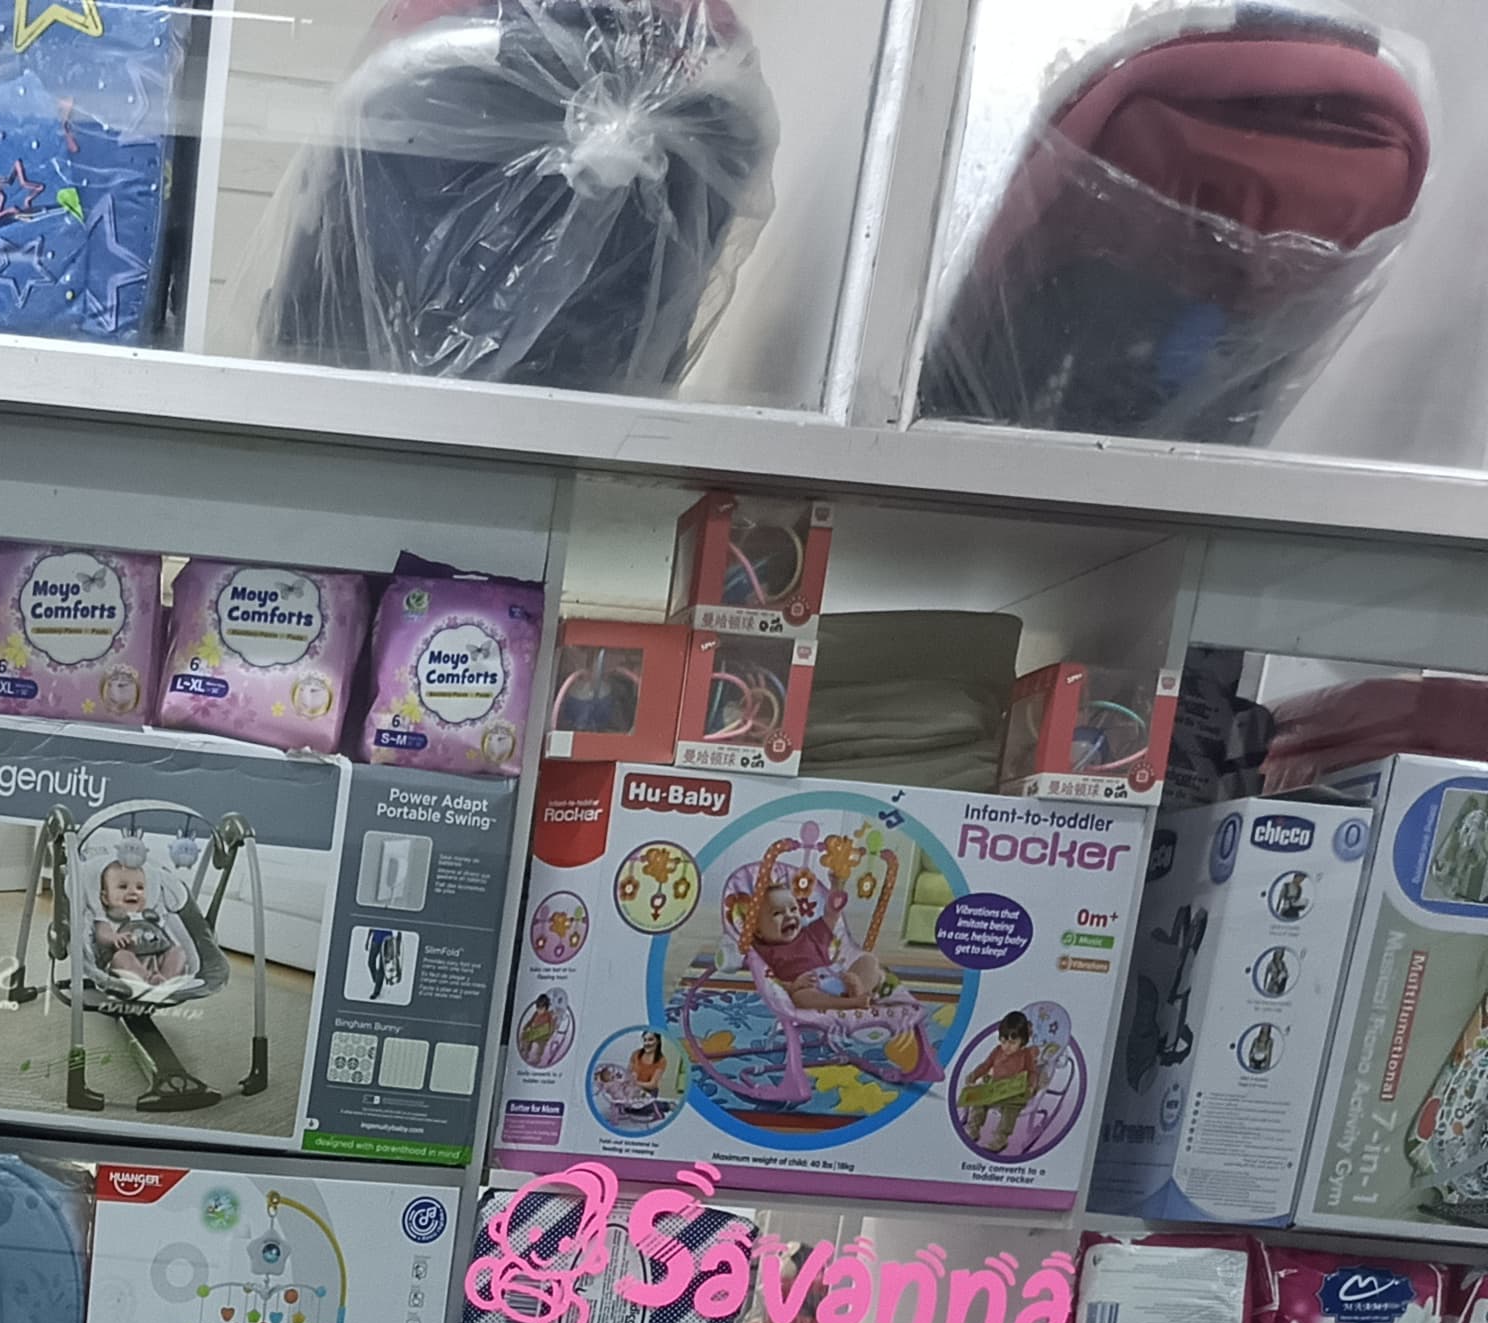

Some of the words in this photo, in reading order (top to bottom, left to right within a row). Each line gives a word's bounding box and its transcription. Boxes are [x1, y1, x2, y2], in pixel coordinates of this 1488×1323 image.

[32, 580, 81, 602] Moyo
[230, 586, 279, 607] Moyo
[31, 601, 117, 619] Comforts
[227, 605, 314, 628] Comforts
[428, 649, 470, 669] Moyo
[425, 668, 498, 687] Comforts
[388, 787, 438, 808] Power
[441, 794, 490, 813] Adapt
[376, 803, 442, 823] Portable
[543, 807, 604, 823] Rocker
[964, 803, 1114, 833] Infant-to-toddler
[1254, 820, 1312, 846] chicco
[957, 824, 1131, 872] Rocker
[955, 904, 999, 918] Vibrations
[1001, 910, 1020, 920] that
[957, 918, 988, 930] imitate
[989, 920, 1015, 933] being
[970, 931, 1003, 946] helping
[955, 944, 971, 956] get
[971, 944, 981, 954] to
[334, 1017, 373, 1031] Bingham
[1381, 954, 1426, 1100] Multifunctional
[1337, 1079, 1370, 1154] Activity
[314, 1136, 355, 1149] designed
[356, 1140, 375, 1150] with
[376, 1141, 427, 1156] parenthood
[428, 1147, 437, 1156] in
[712, 1152, 750, 1162] Maximum
[1352, 1110, 1398, 1204] 7-in-1
[961, 1161, 986, 1172] Easily
[988, 1165, 1026, 1175] converts
[1327, 1158, 1353, 1207] Gym
